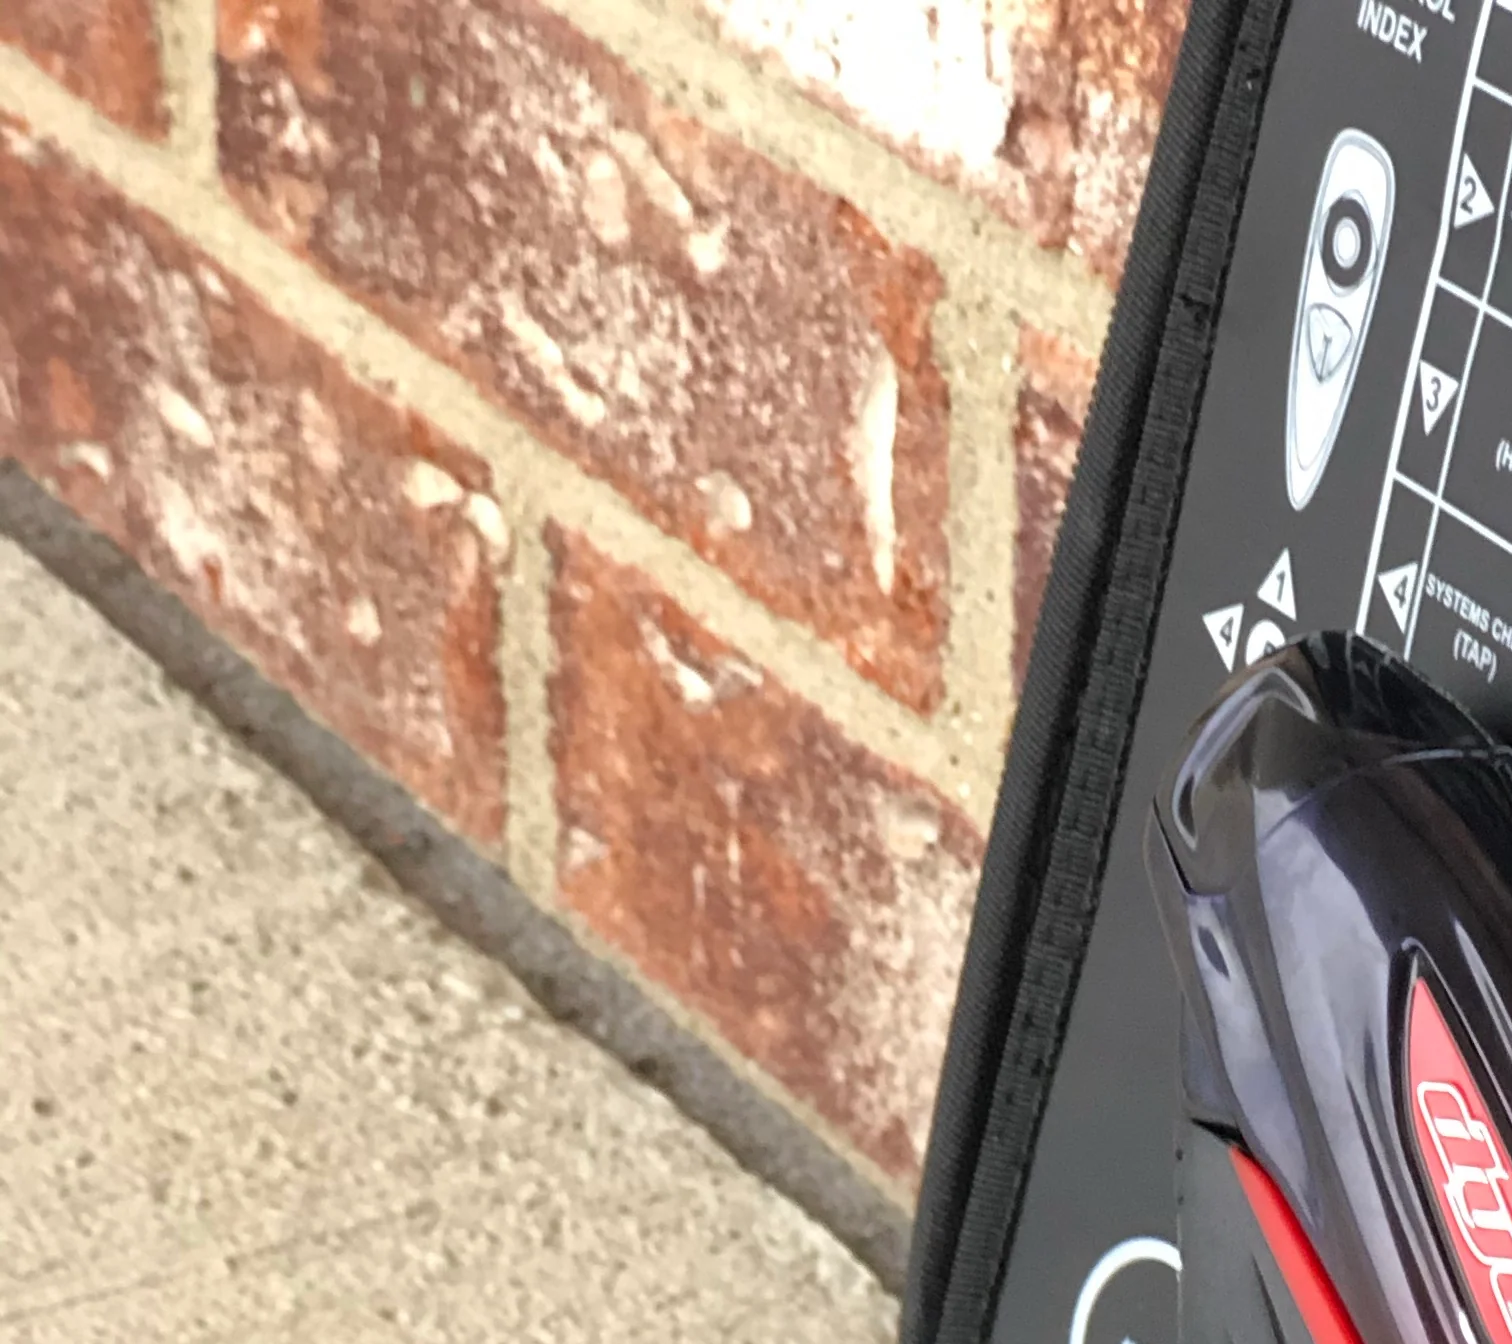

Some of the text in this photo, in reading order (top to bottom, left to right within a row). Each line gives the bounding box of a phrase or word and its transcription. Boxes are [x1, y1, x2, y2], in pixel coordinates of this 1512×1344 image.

[1356, 0, 1428, 63] INDEX
[1425, 572, 1490, 632] SYSTEMS
[1453, 628, 1498, 684] (TAP)
